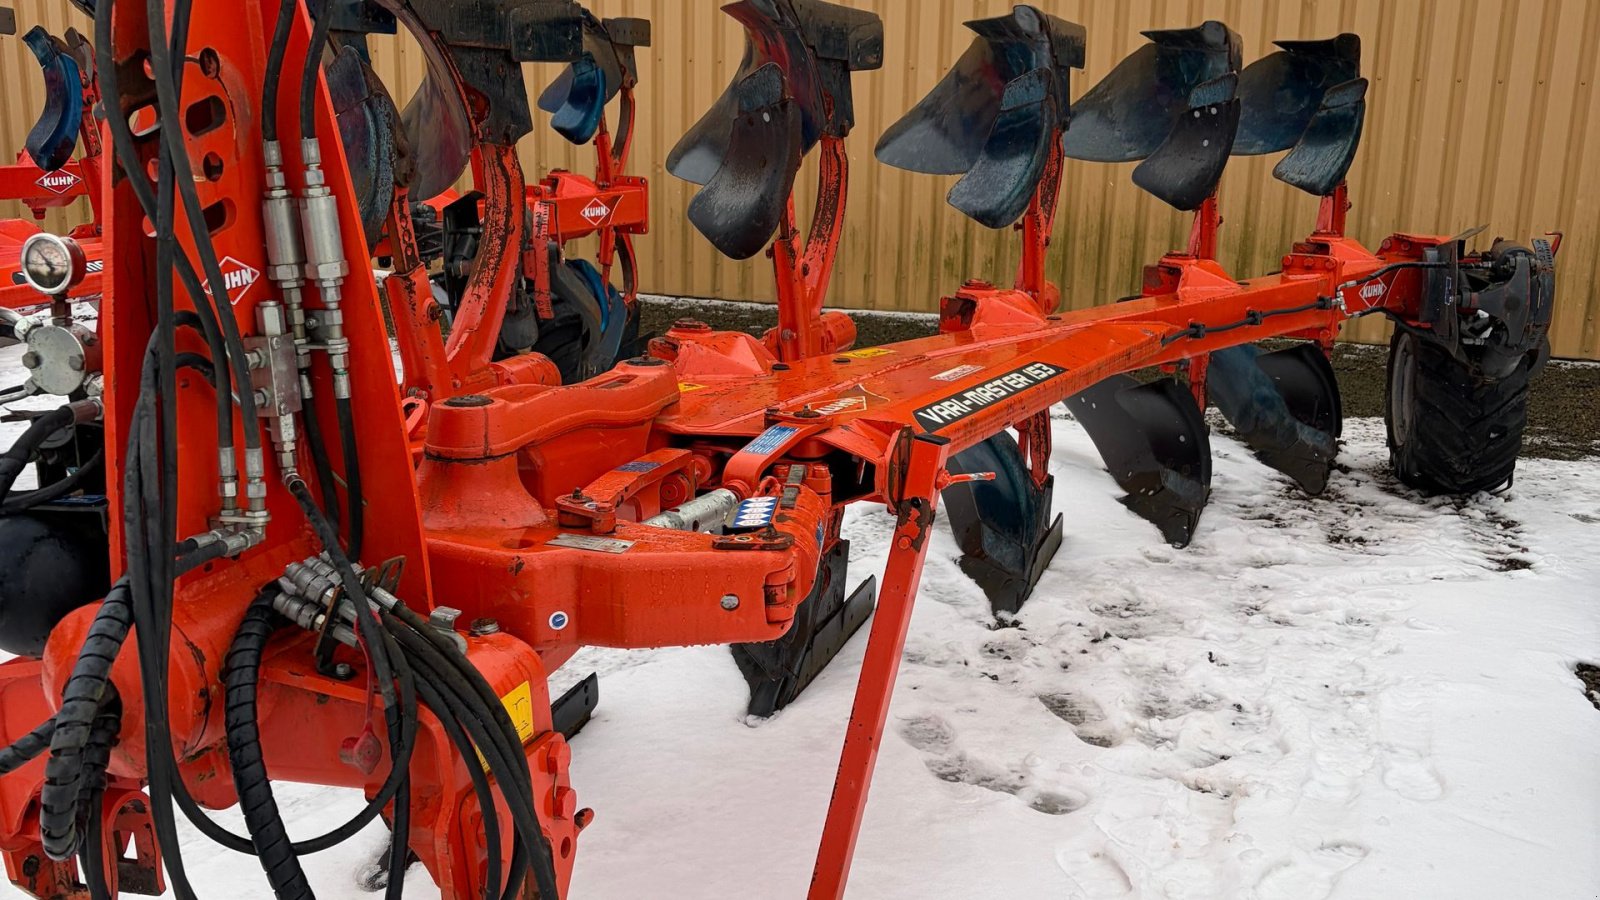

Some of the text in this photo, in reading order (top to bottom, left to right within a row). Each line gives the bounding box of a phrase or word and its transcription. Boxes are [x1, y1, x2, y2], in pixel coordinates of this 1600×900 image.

[43, 176, 74, 187] KUHN
[585, 205, 606, 217] KUHN
[1363, 284, 1383, 298] KUHN
[917, 372, 1034, 424] VARI-MASTER
[1023, 362, 1057, 380] 153
